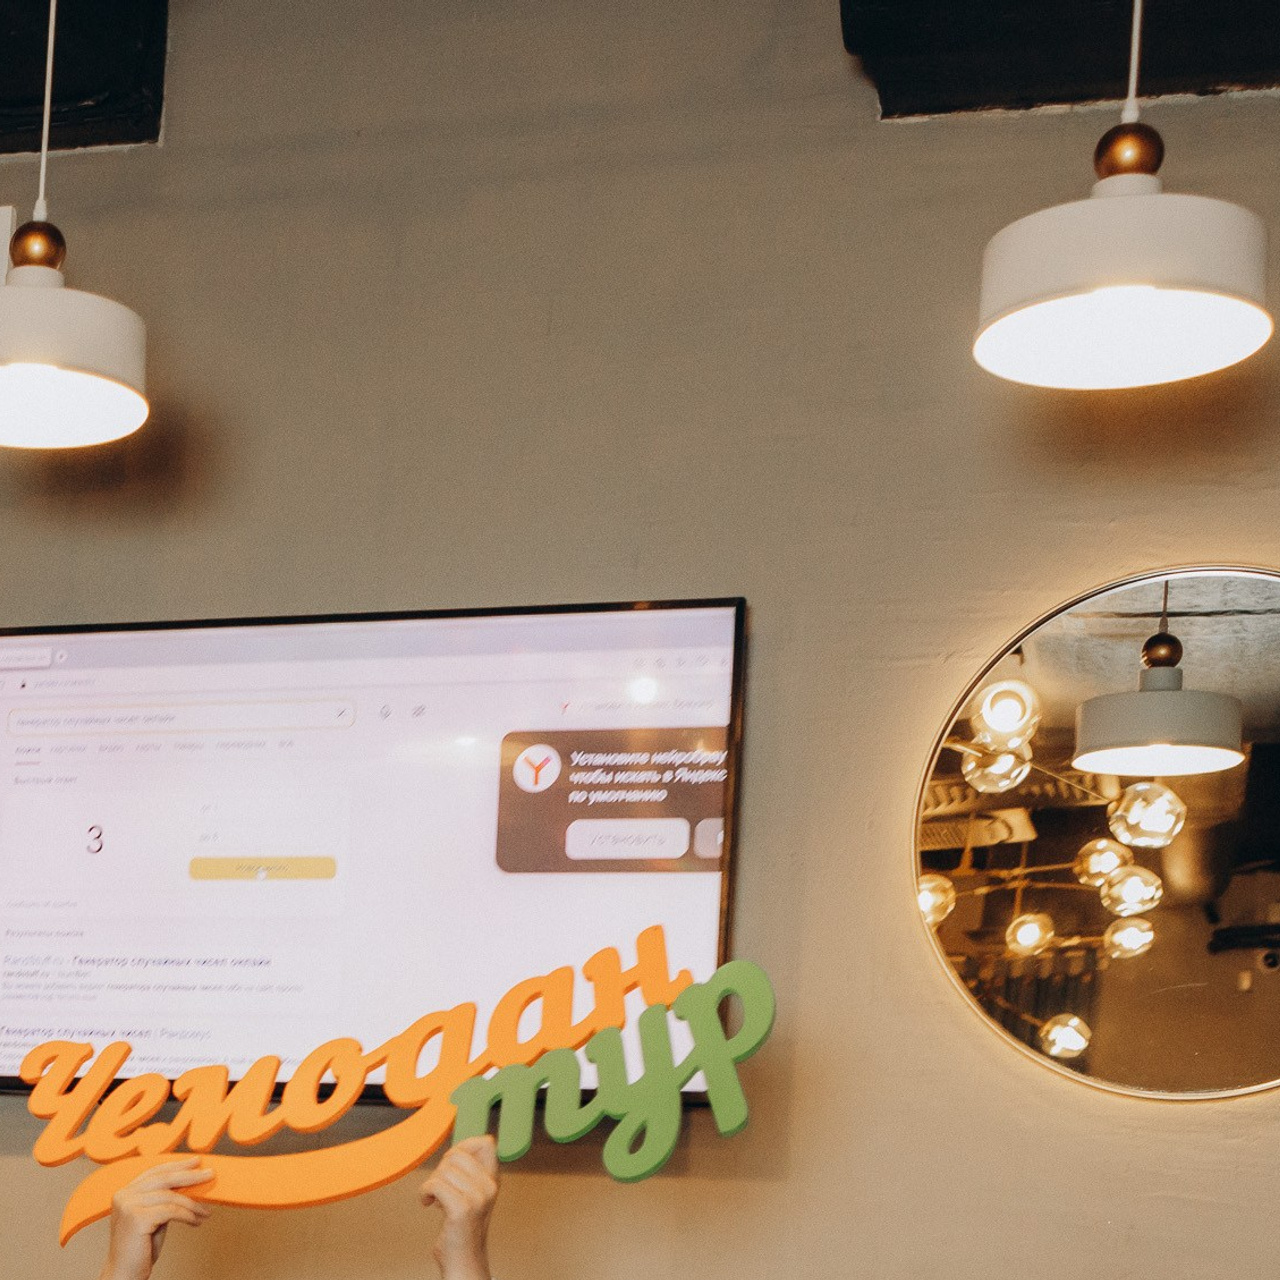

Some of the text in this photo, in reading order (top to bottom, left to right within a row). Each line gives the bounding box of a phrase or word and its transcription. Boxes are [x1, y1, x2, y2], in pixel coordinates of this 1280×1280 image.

[86, 824, 104, 854] 3
[20, 925, 694, 1248] Чемодан
[448, 960, 777, 1184] тур
